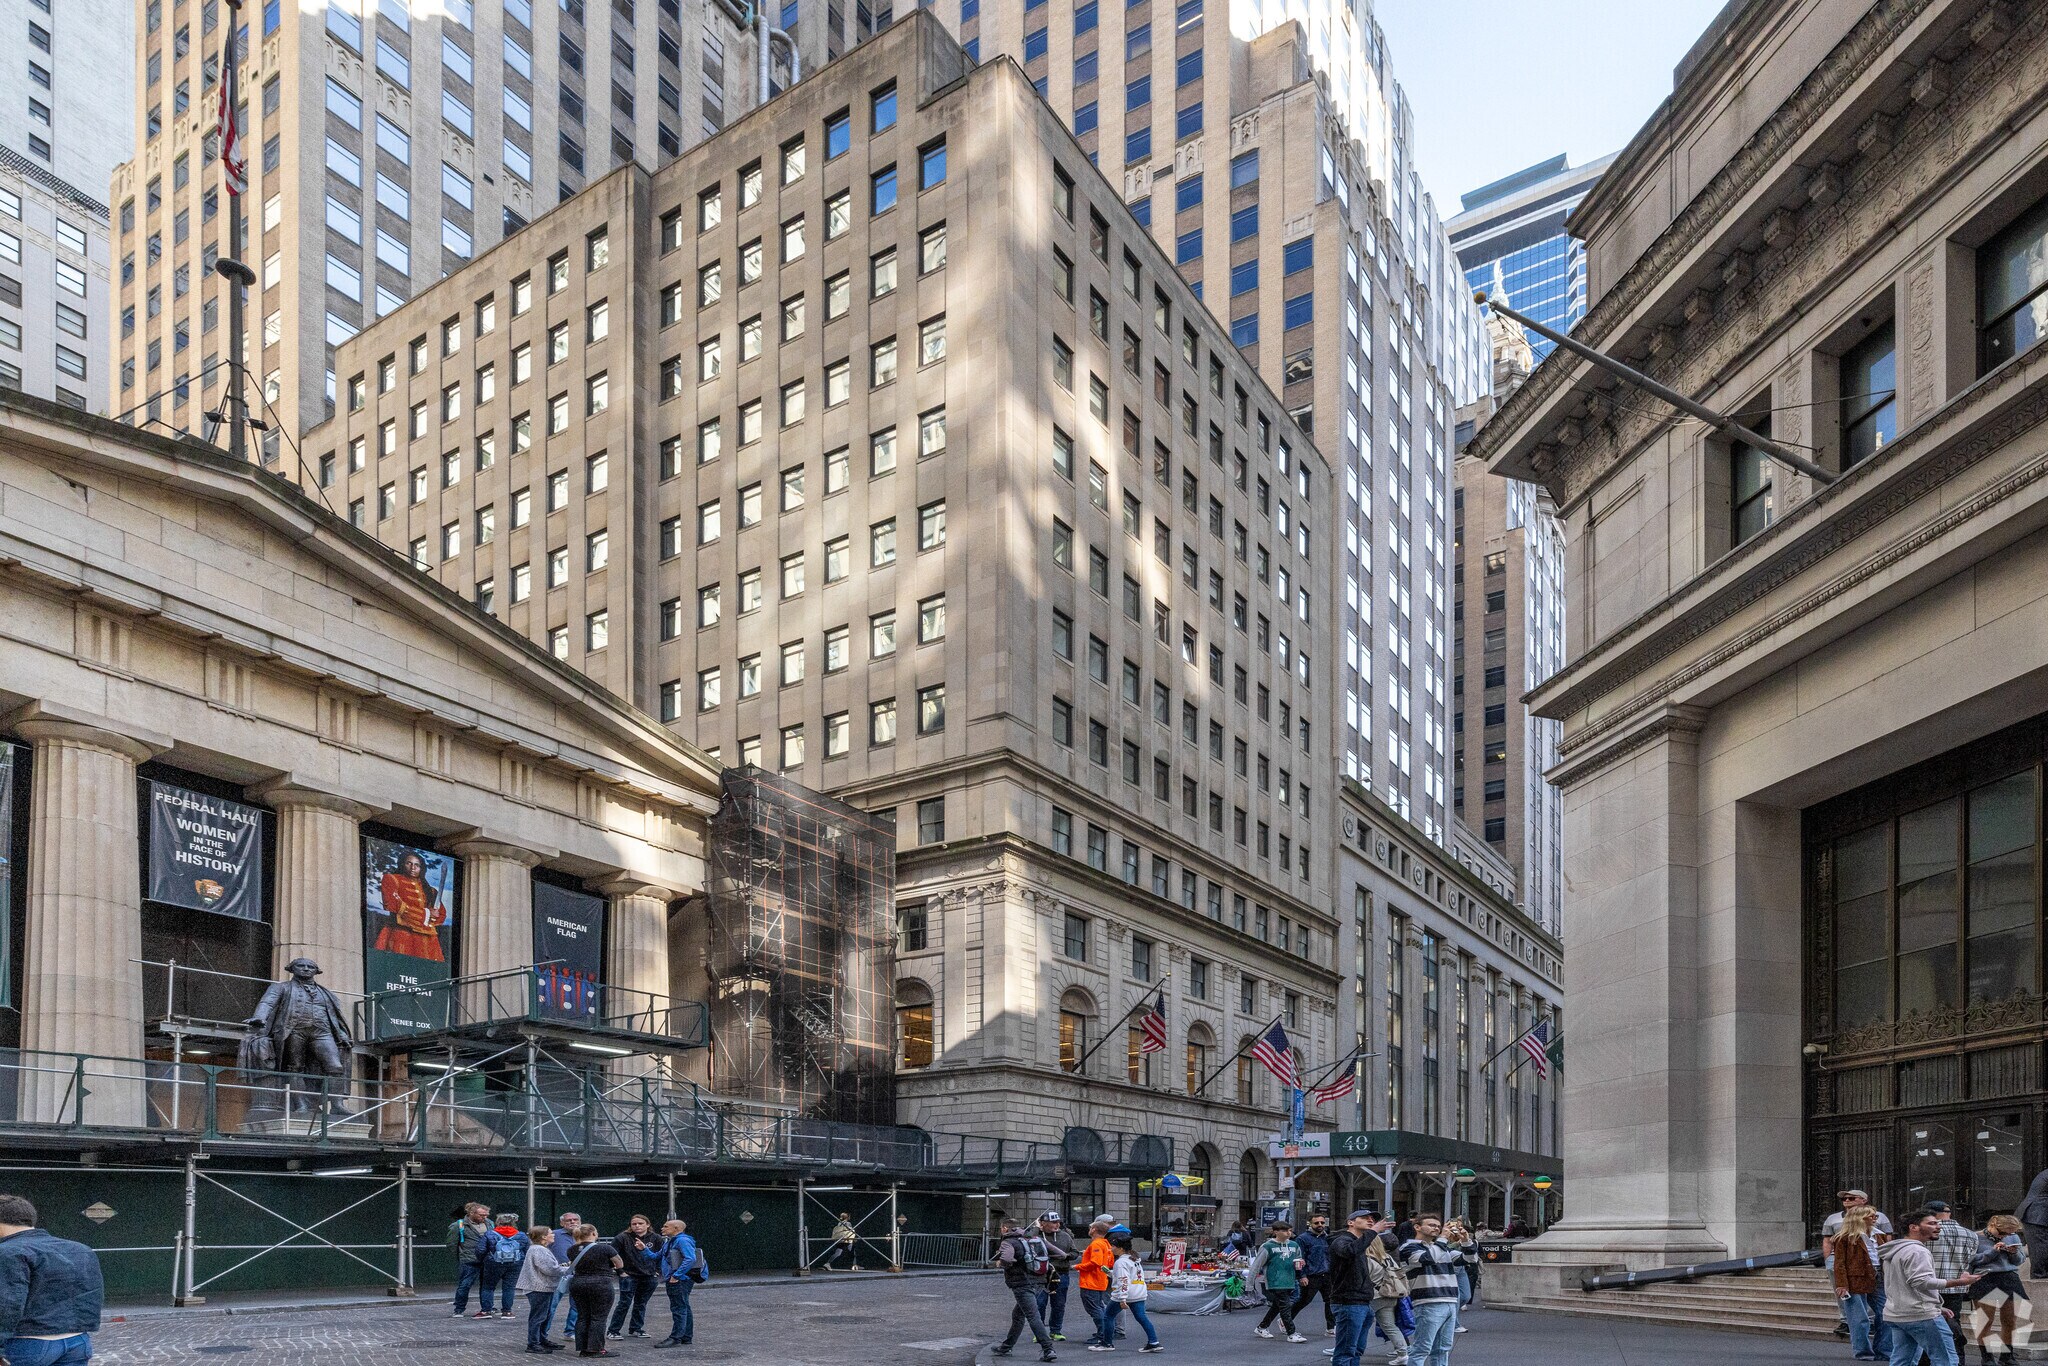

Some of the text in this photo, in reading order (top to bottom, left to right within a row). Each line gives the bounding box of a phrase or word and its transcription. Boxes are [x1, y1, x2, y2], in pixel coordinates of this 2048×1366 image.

[155, 792, 257, 827] FEDERAL HALL
[176, 818, 237, 843] WOMEN
[189, 843, 227, 858] FACE OF
[193, 836, 224, 850] IN THE
[175, 850, 242, 875] HISTORY
[547, 917, 588, 933] AMERICAN
[557, 927, 577, 939] FLAG
[386, 982, 406, 992] RED
[399, 974, 418, 985] THE
[391, 1017, 431, 1029] RENEE COX
[1342, 1135, 1368, 1151] 40
